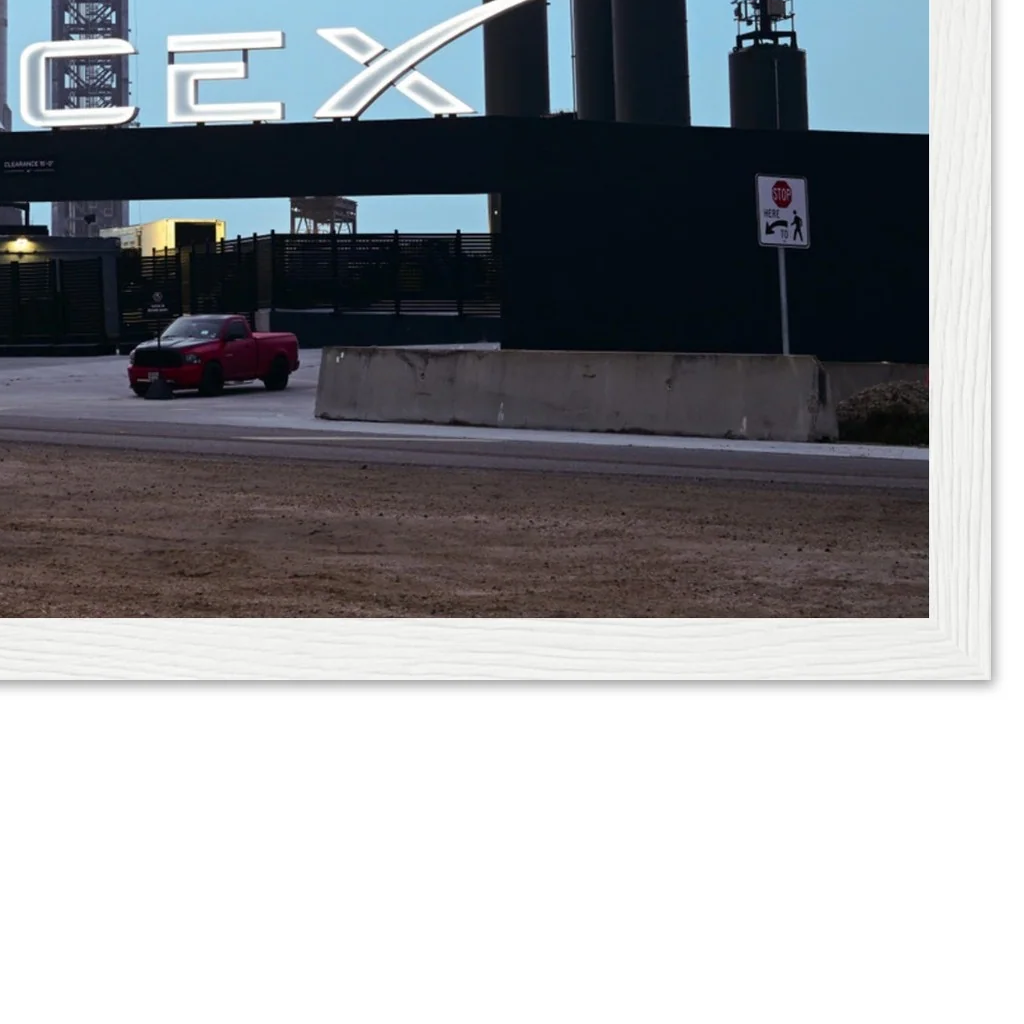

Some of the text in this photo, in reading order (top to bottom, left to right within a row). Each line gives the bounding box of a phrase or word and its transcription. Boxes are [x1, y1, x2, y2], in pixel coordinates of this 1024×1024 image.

[773, 187, 792, 201] STOP
[763, 208, 781, 219] HERE
[780, 228, 789, 239] TO
